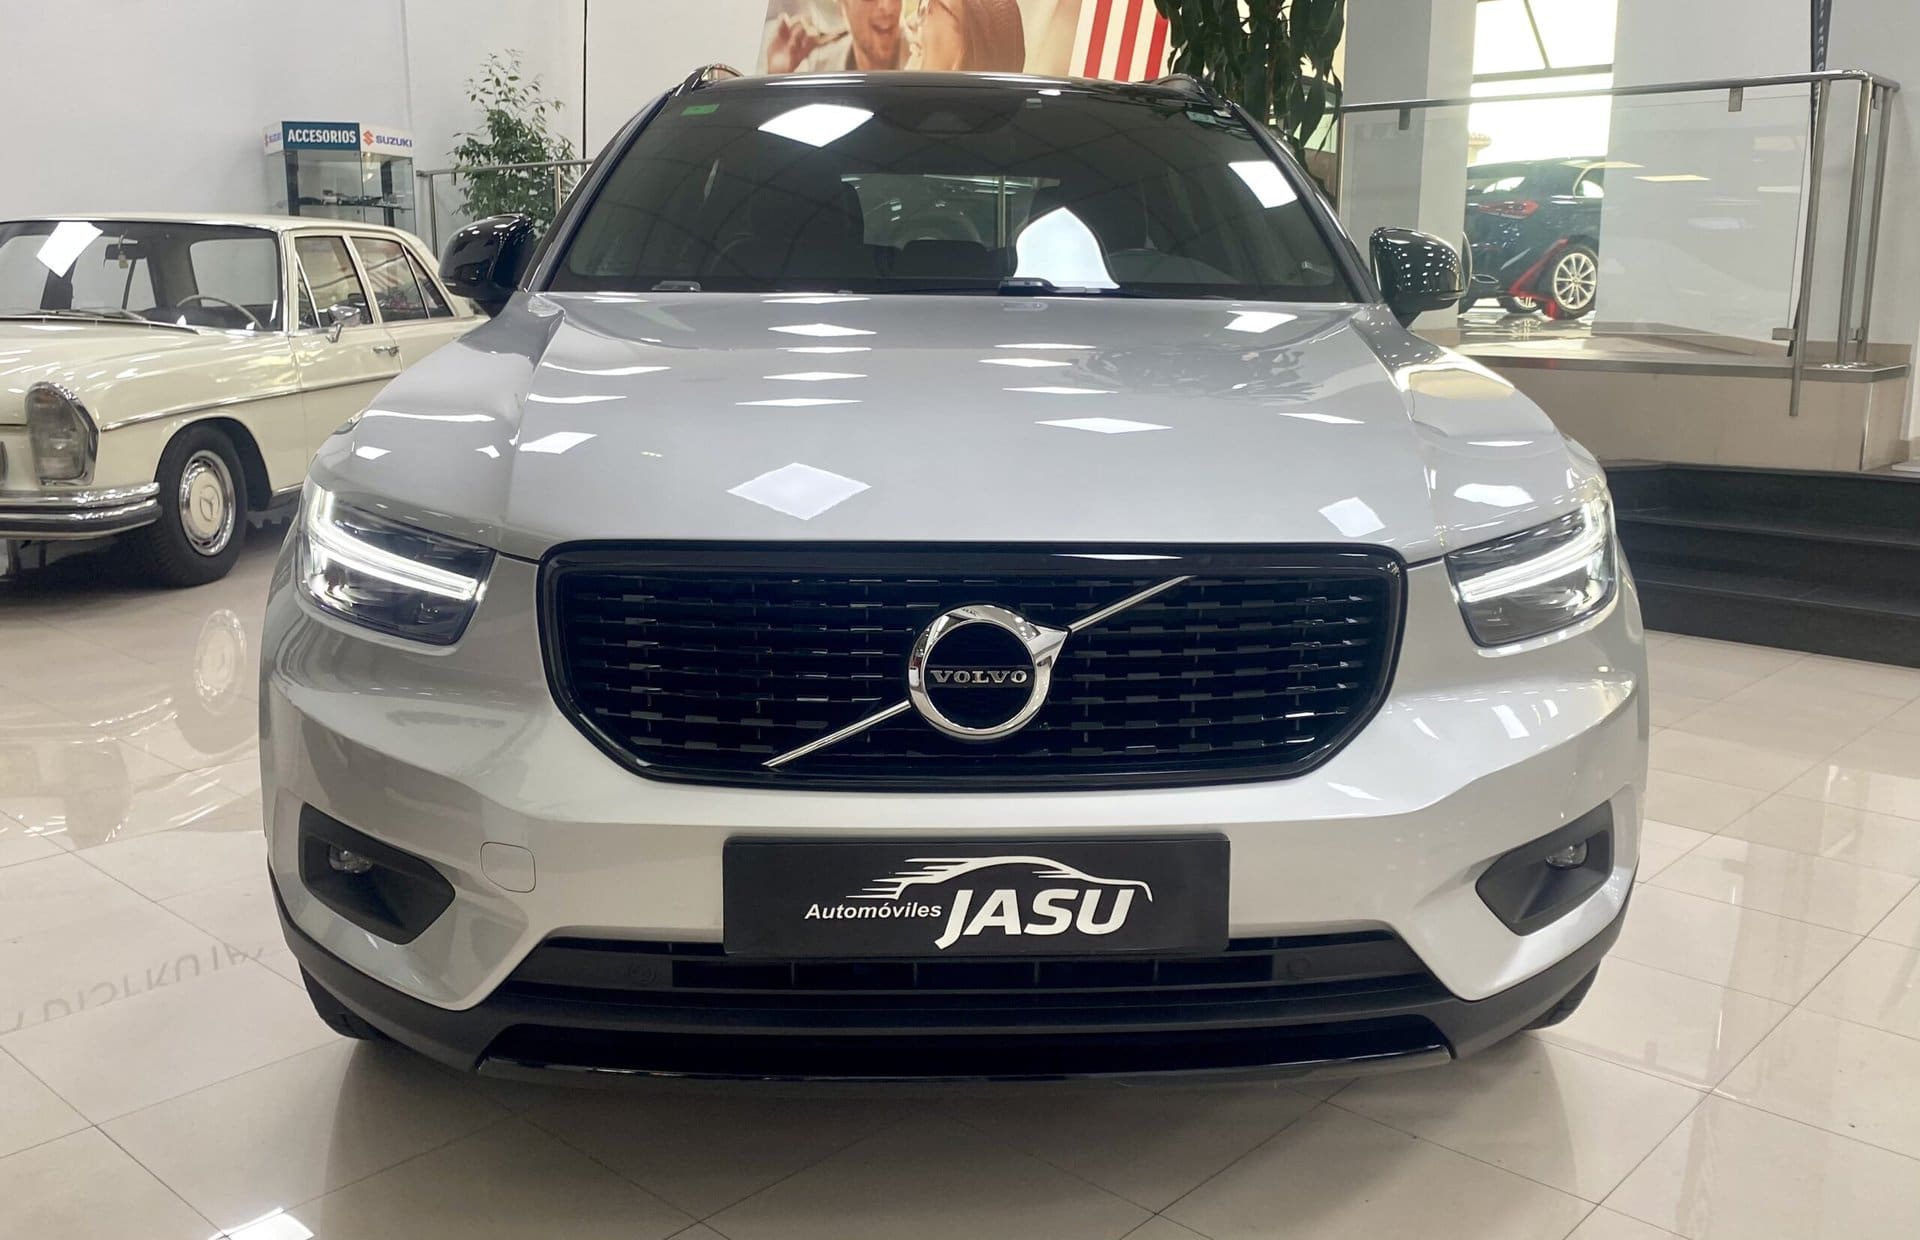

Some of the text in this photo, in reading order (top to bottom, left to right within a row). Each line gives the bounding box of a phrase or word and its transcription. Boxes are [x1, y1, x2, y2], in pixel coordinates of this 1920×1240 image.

[288, 129, 357, 144] ACCESORIOS
[375, 135, 412, 147] SUZUKI
[930, 670, 1028, 684] VOLVO
[804, 888, 1135, 950] Automóviles JASU
